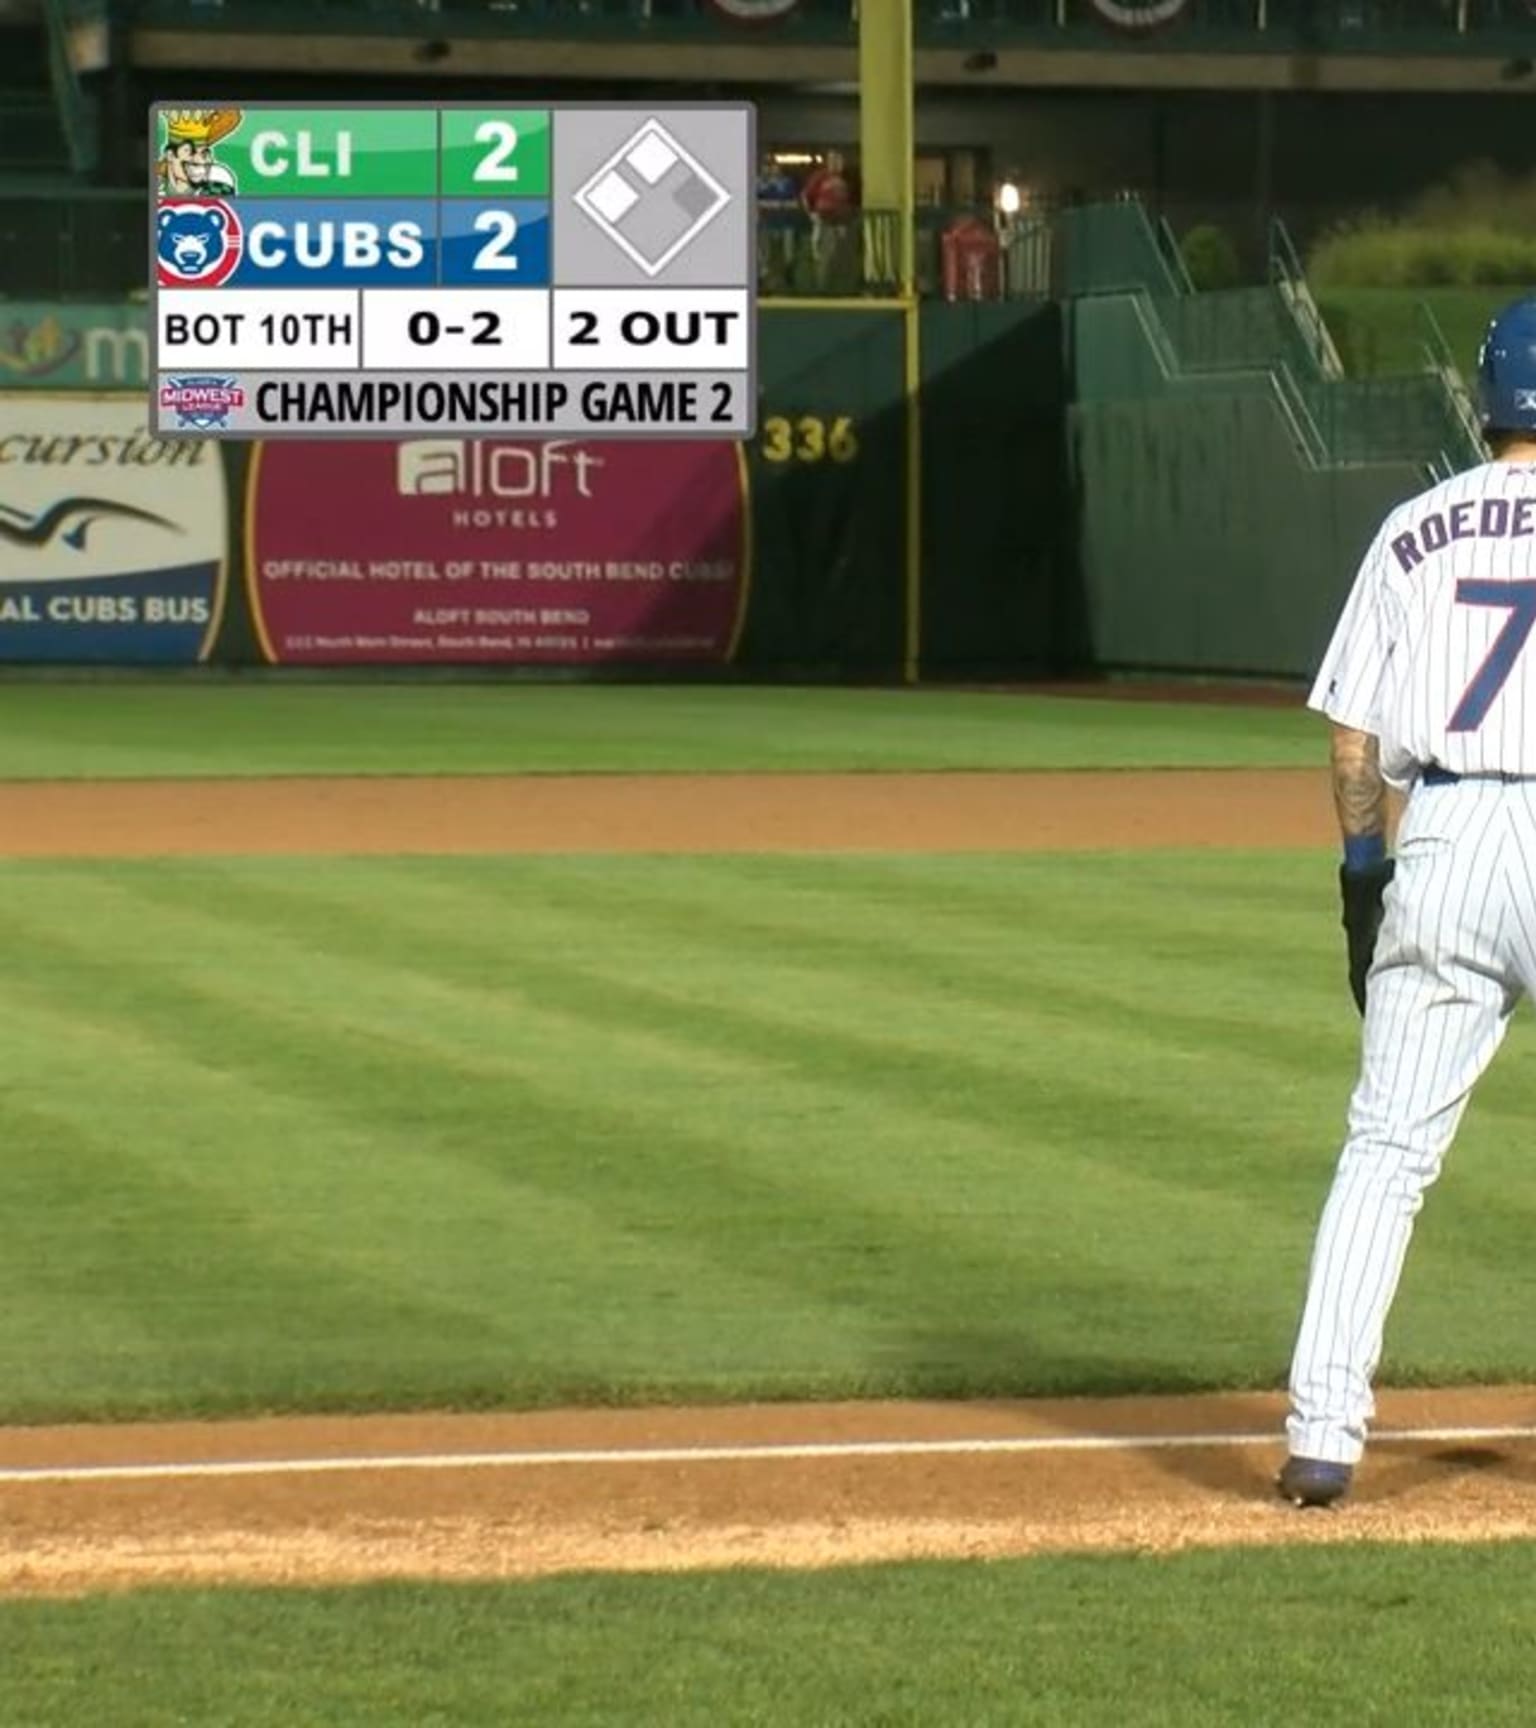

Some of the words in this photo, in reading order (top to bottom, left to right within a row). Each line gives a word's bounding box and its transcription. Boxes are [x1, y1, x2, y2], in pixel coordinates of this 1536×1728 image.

[763, 415, 858, 461] 336
[397, 438, 605, 497] aloft
[453, 509, 558, 528] HOTELS
[263, 560, 364, 580] OFFICIAL
[368, 560, 440, 580] HOTEL
[446, 560, 475, 580] OF
[479, 560, 521, 580] THE
[527, 560, 601, 580] SOUTH
[605, 560, 665, 580] BEND
[48, 596, 137, 622] CUBS
[145, 596, 209, 622] BUS
[413, 608, 470, 625] ALOFT
[474, 608, 536, 625] SOUTH
[540, 608, 591, 625] BEND
